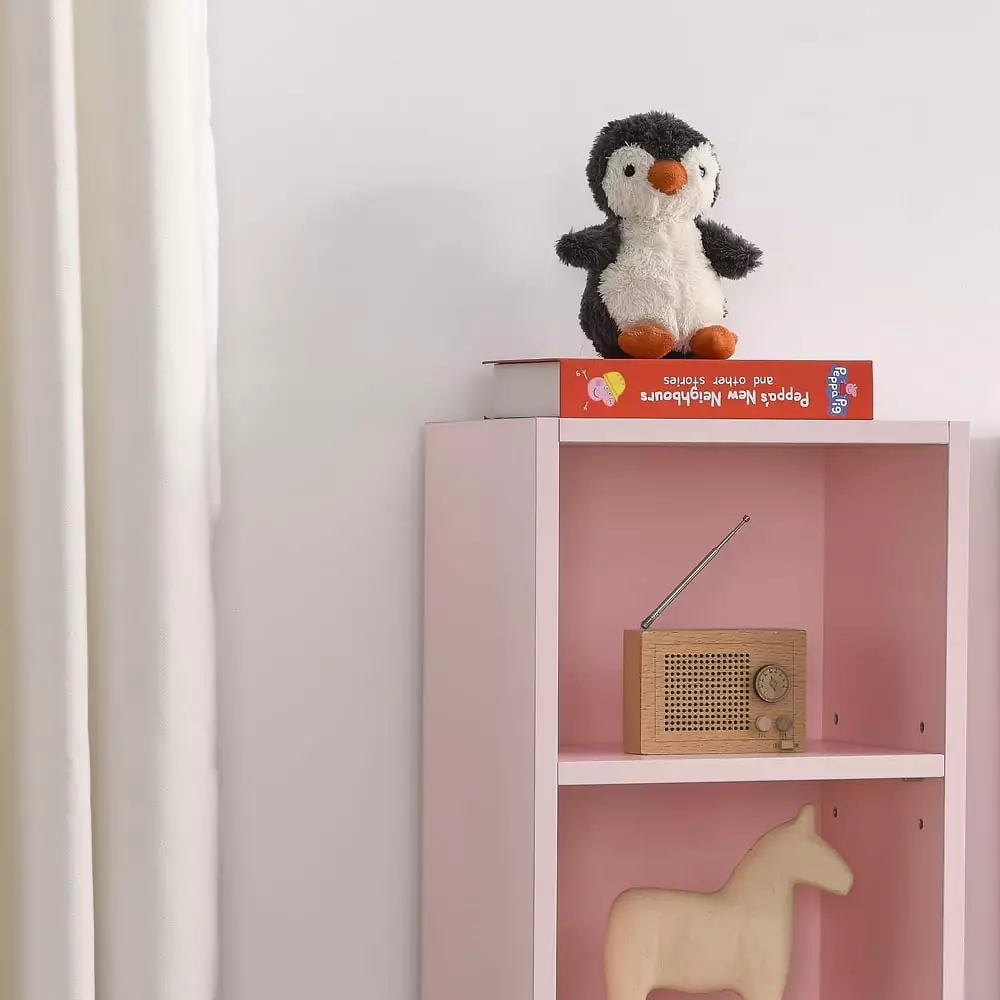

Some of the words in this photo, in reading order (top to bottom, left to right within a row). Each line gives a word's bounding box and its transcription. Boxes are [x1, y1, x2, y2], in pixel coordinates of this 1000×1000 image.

[663, 376, 705, 385] stories
[713, 376, 746, 385] other
[754, 376, 774, 385] and
[827, 366, 846, 397] Peppa
[640, 387, 722, 407] Neighbours
[728, 389, 756, 405] New
[761, 387, 810, 407] Peppa's
[831, 397, 848, 414] Pig
